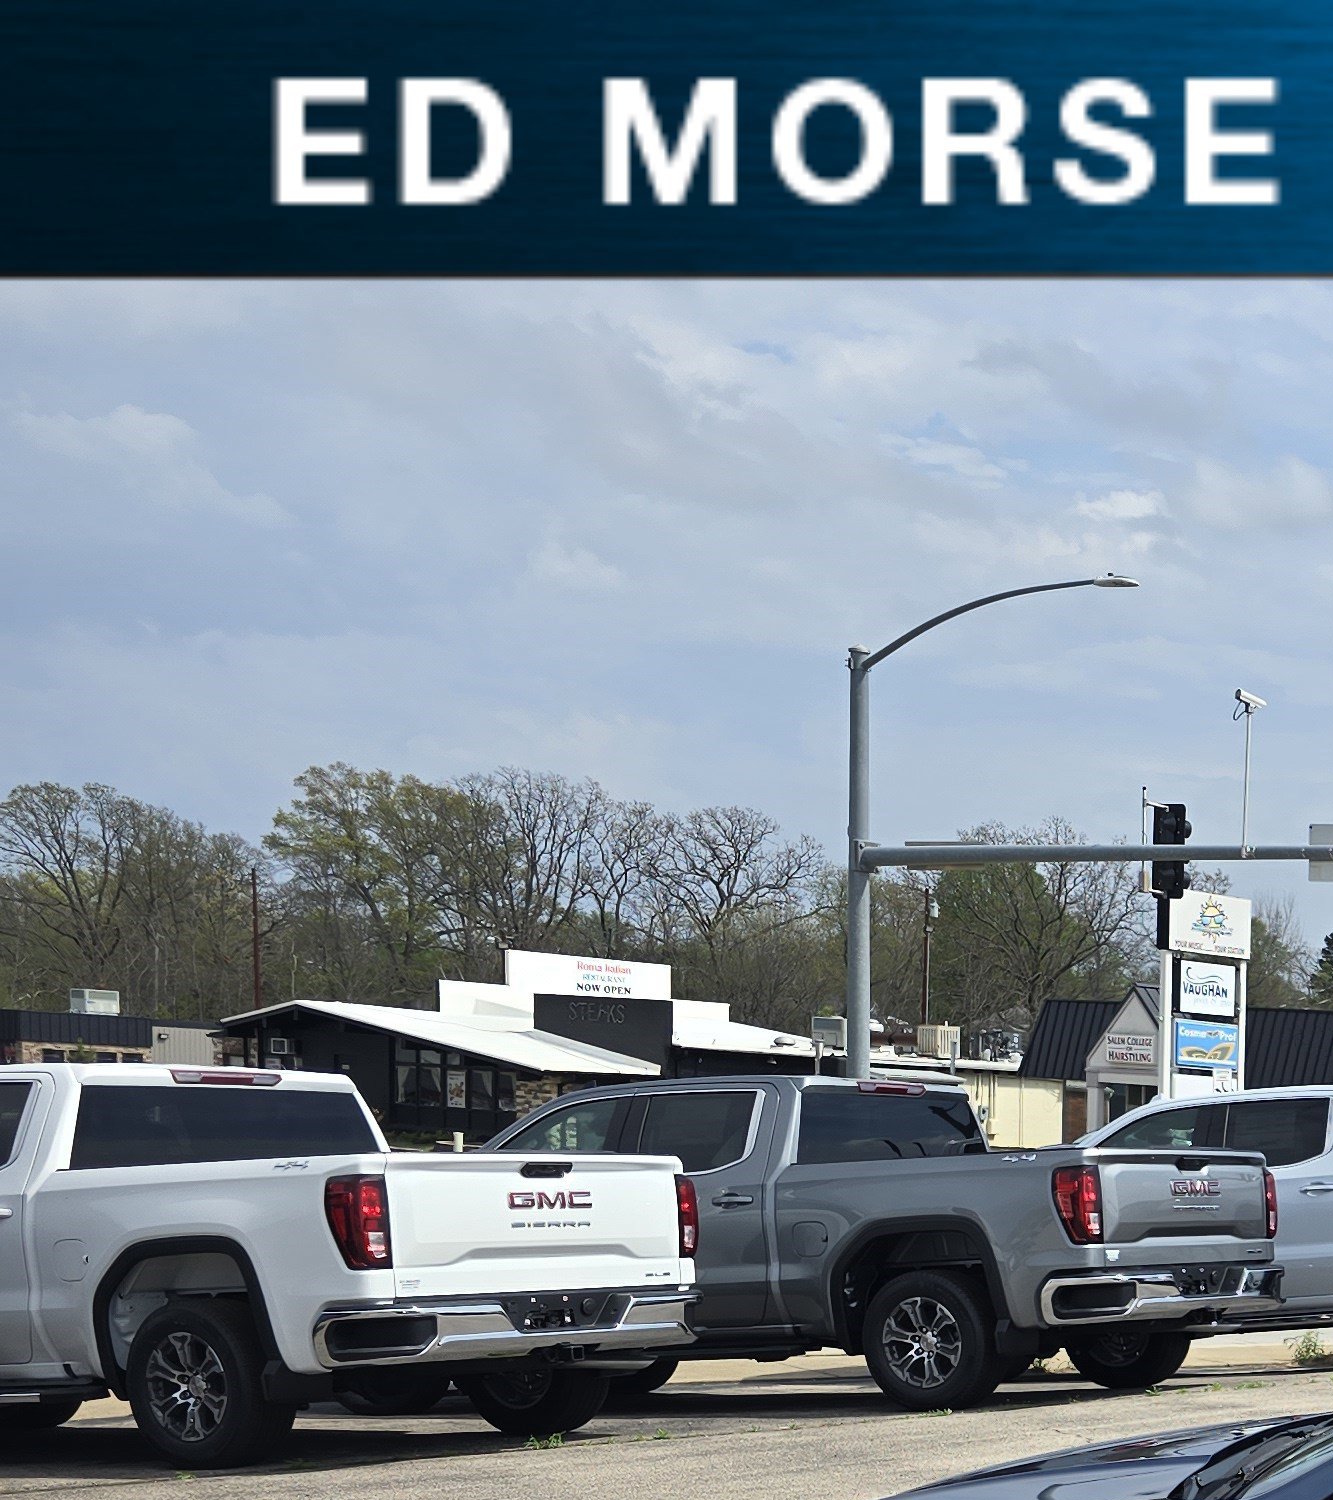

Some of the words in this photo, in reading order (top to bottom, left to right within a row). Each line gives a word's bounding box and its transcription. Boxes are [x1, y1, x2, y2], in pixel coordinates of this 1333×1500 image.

[577, 960, 602, 972] Roma
[576, 983, 601, 992] NOW
[603, 985, 632, 995] OPEN
[1182, 981, 1228, 998] VAUGHAN
[568, 1001, 626, 1024] STEAKS
[1179, 1026, 1207, 1038] Cosmo
[1169, 1179, 1222, 1197] GMC
[507, 1190, 593, 1210] GMC
